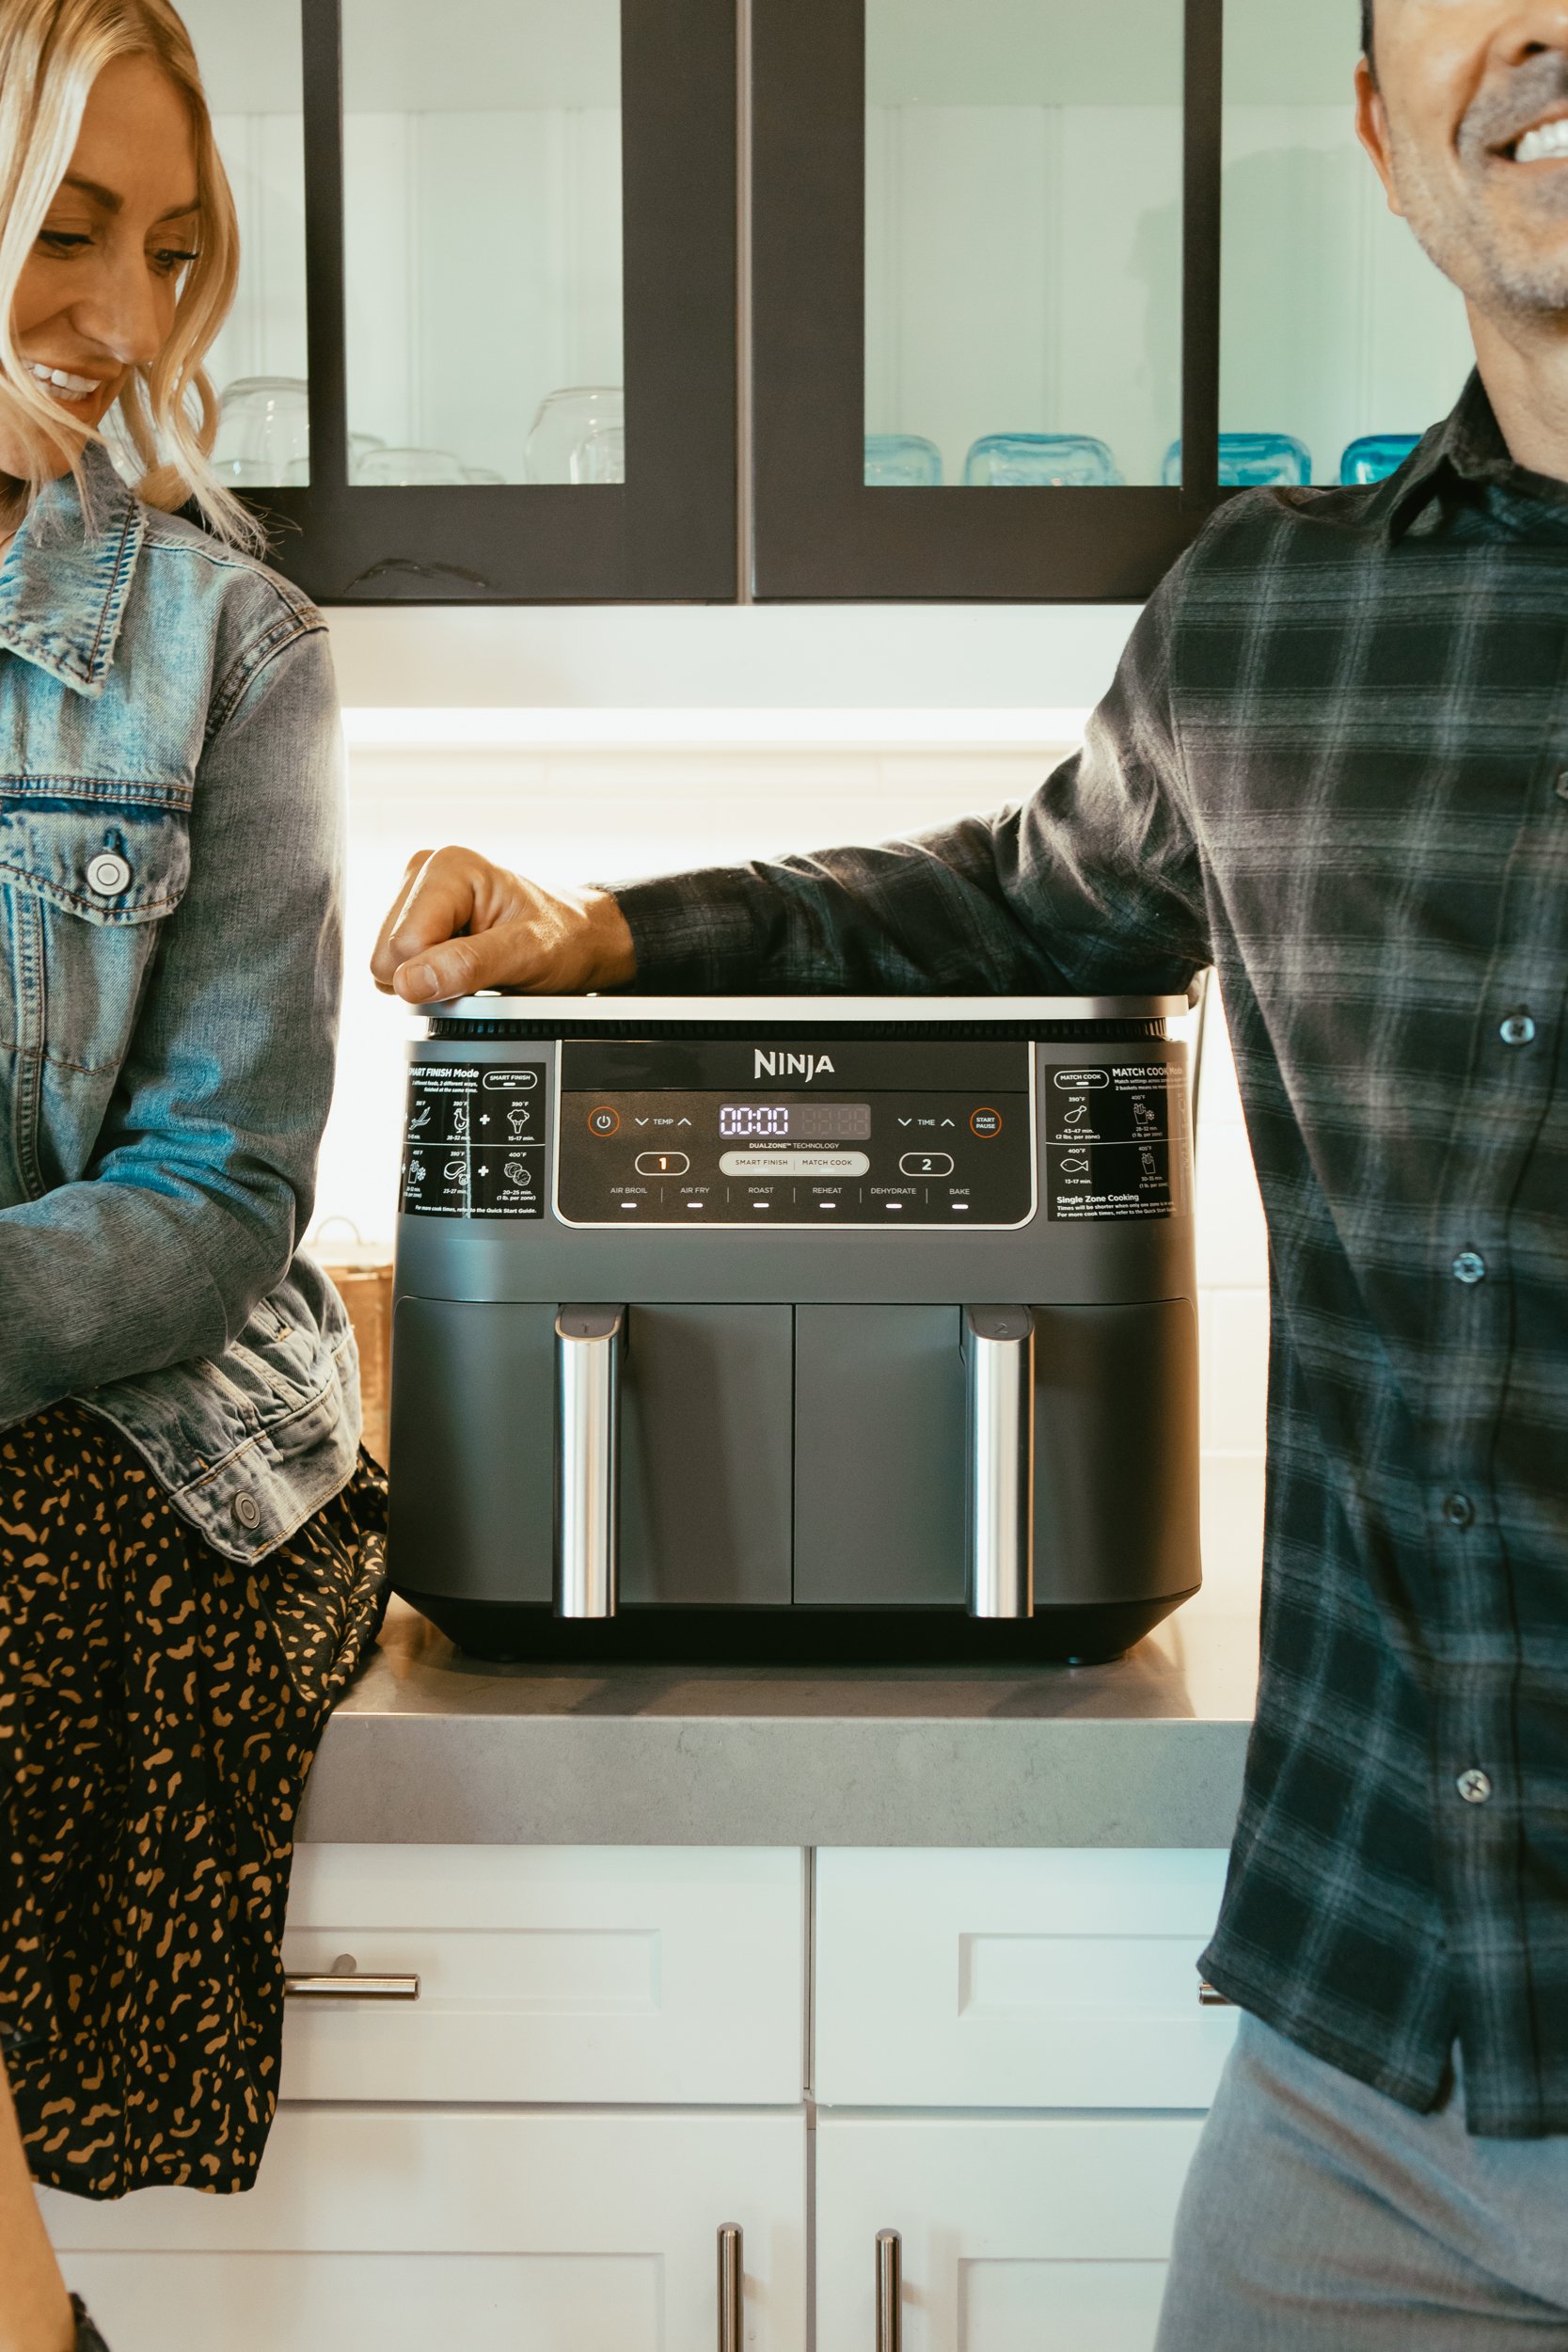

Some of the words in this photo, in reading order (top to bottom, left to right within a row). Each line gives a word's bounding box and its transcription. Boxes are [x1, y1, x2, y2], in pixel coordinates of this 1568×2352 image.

[754, 1048, 835, 1083] NINJA
[426, 1068, 452, 1077] FINISH
[453, 1069, 480, 1078] Mode
[1112, 1068, 1146, 1077] MATCH
[653, 1118, 674, 1126] TEMP
[721, 1107, 788, 1135] 00:00
[917, 1118, 936, 1126] TIME
[659, 1157, 667, 1170] 1
[922, 1158, 932, 1171] 2
[1056, 1196, 1084, 1204] Single
[1107, 1194, 1139, 1202] Cooking
